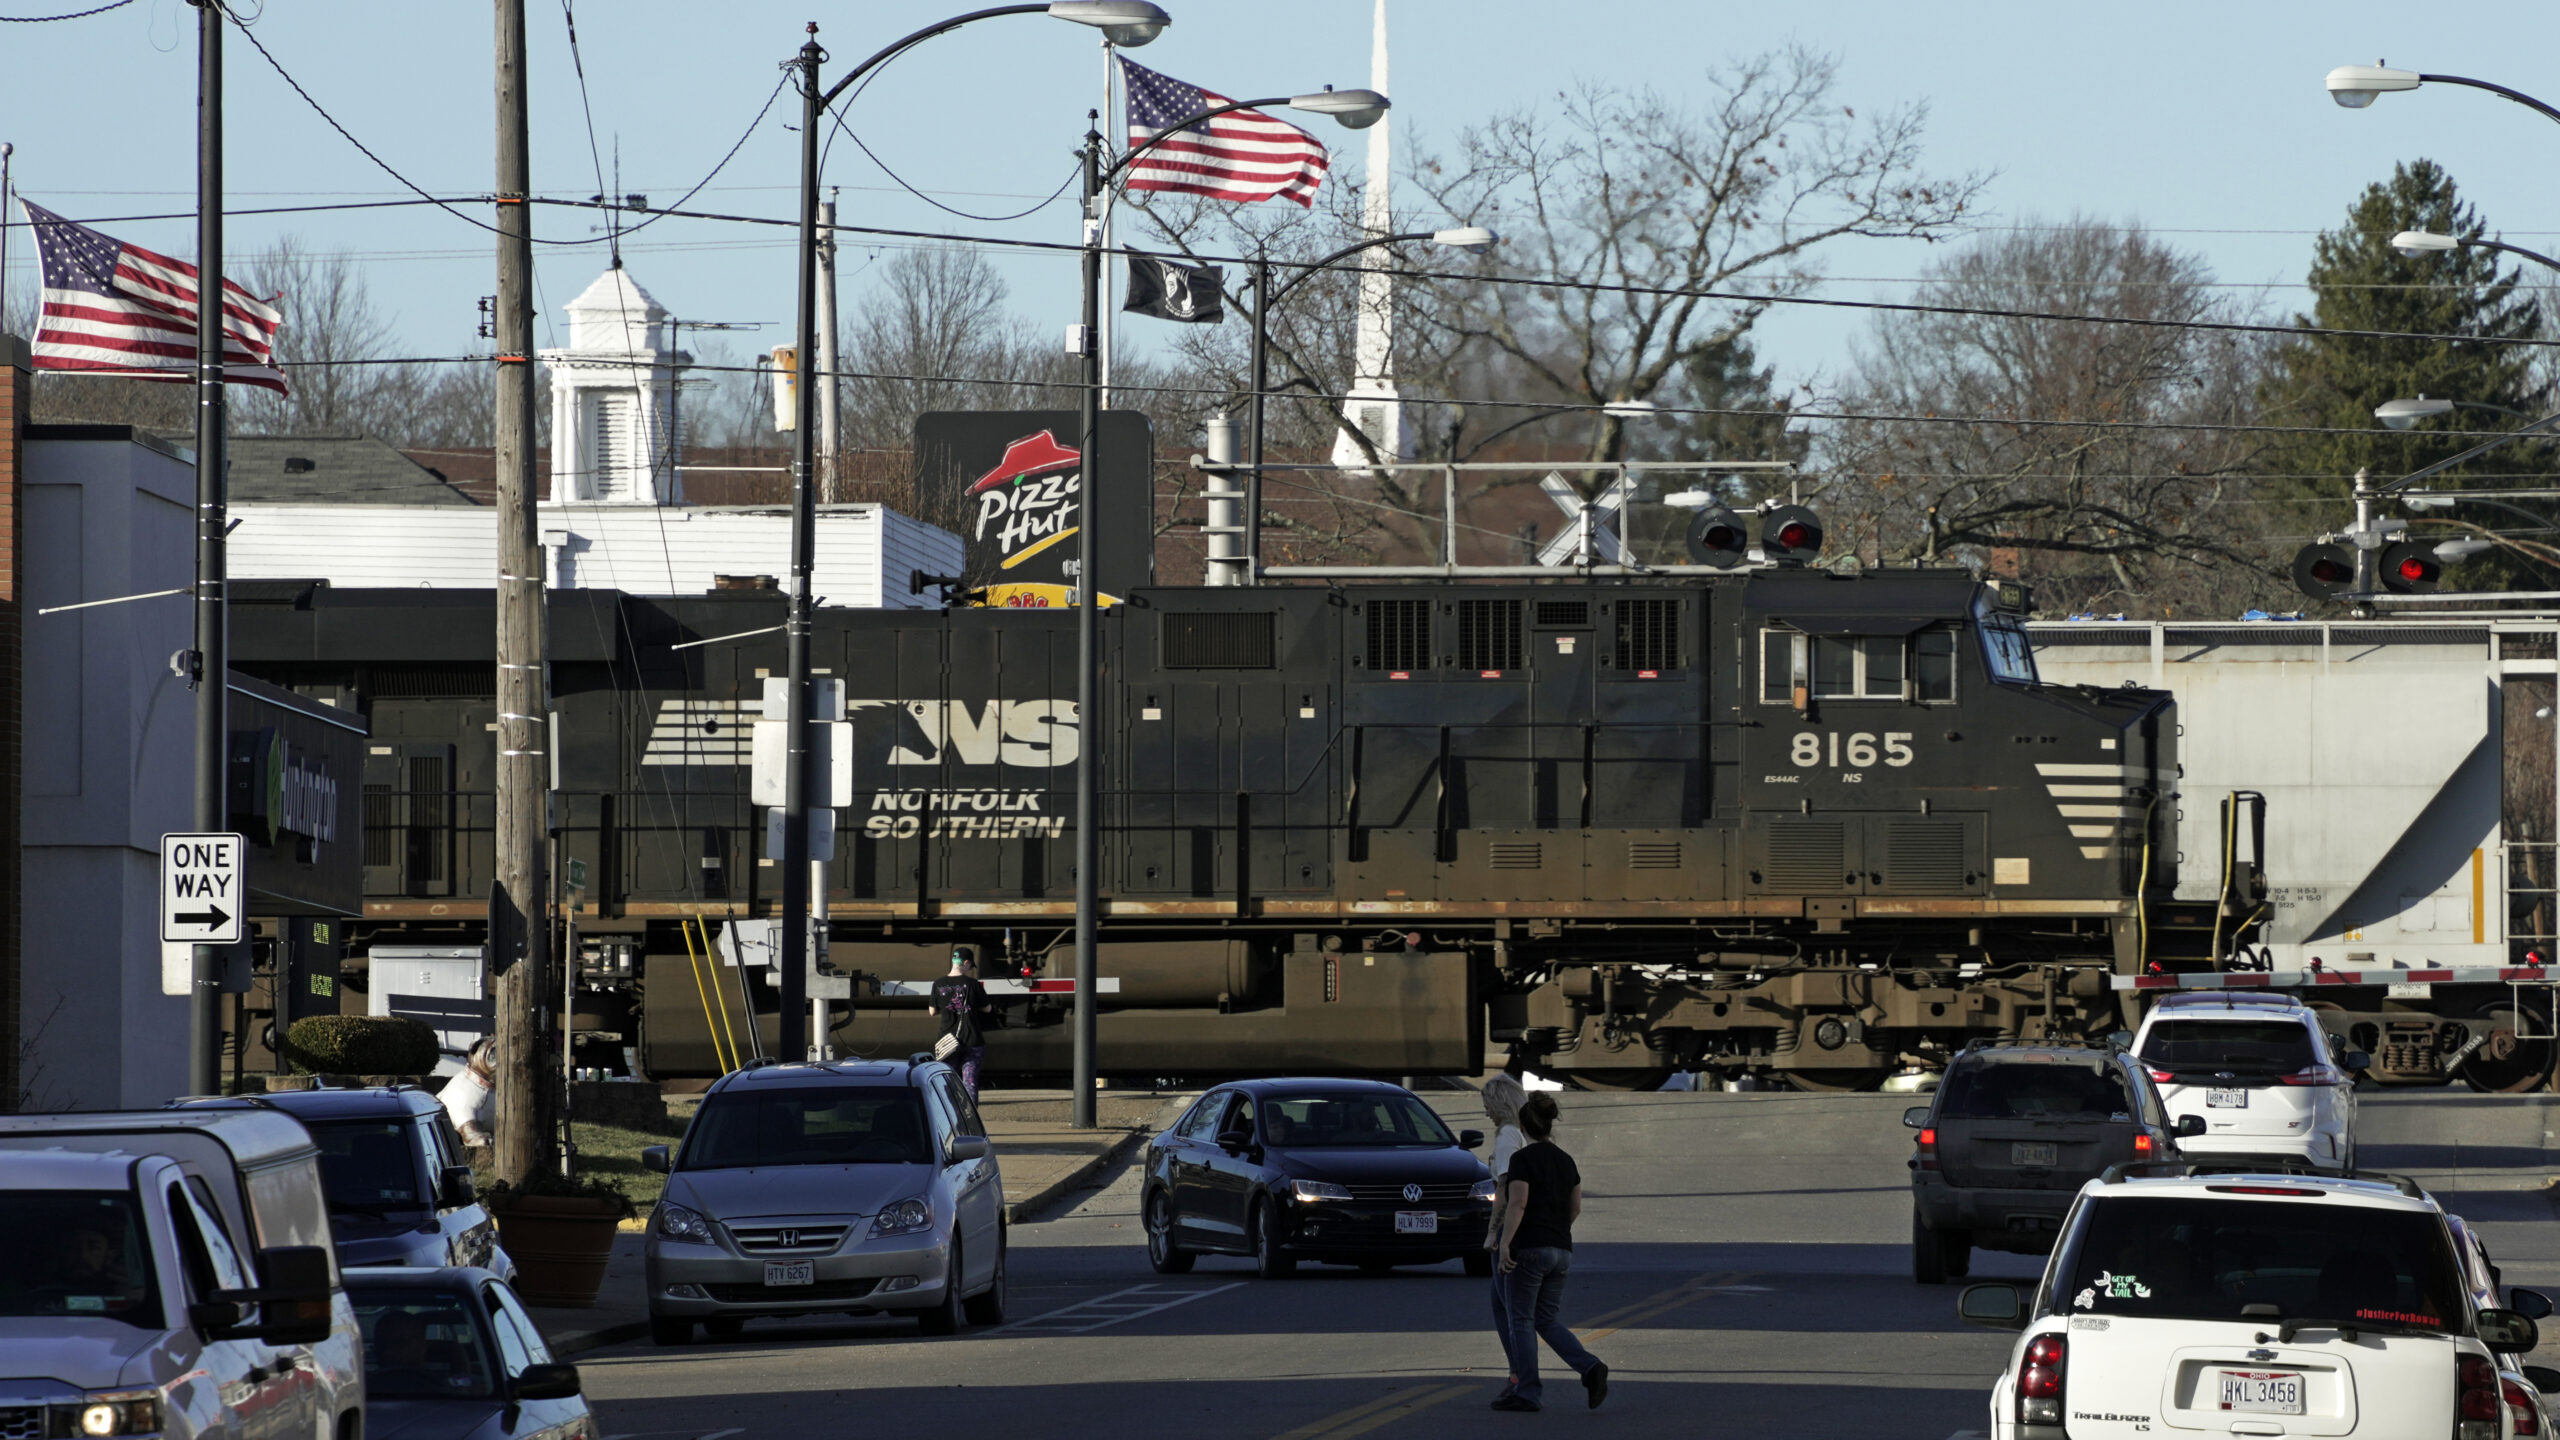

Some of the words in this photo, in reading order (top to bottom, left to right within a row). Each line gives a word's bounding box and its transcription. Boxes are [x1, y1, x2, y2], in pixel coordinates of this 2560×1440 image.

[996, 500, 1080, 554] Hut
[887, 699, 1079, 767] NS
[1791, 732, 1914, 767] 8165
[1764, 775, 1800, 783] ES44AC
[1842, 773, 1863, 783] NS
[871, 788, 1046, 811] NORFOLK
[174, 843, 230, 868] ONE
[174, 874, 232, 898] WAY
[787, 1266, 809, 1279] 6267
[2113, 1288, 2133, 1298] TAIL
[2224, 1380, 2252, 1402] HKL
[2258, 1382, 2296, 1403] 3458
